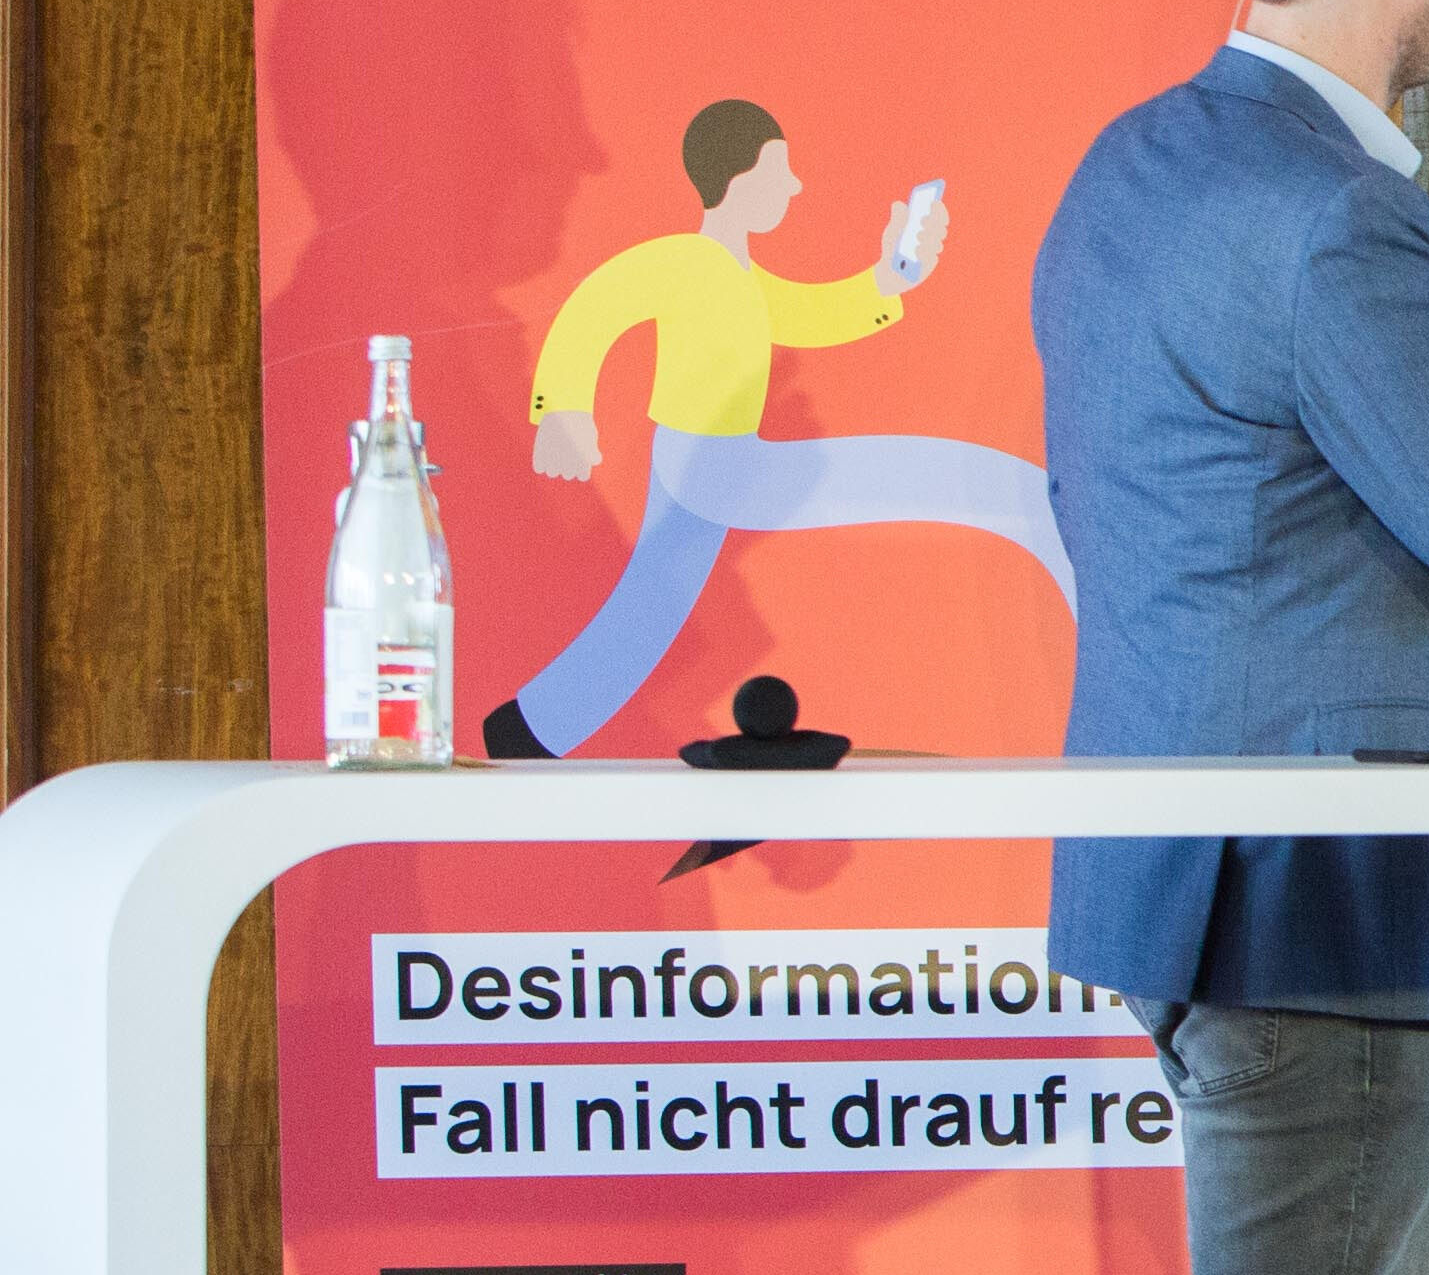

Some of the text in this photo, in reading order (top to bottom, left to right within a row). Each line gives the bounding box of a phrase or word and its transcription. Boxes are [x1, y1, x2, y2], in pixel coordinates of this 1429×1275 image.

[399, 1083, 546, 1156] Fall
[576, 1081, 807, 1153] nicht
[831, 1075, 1067, 1150] drauf
